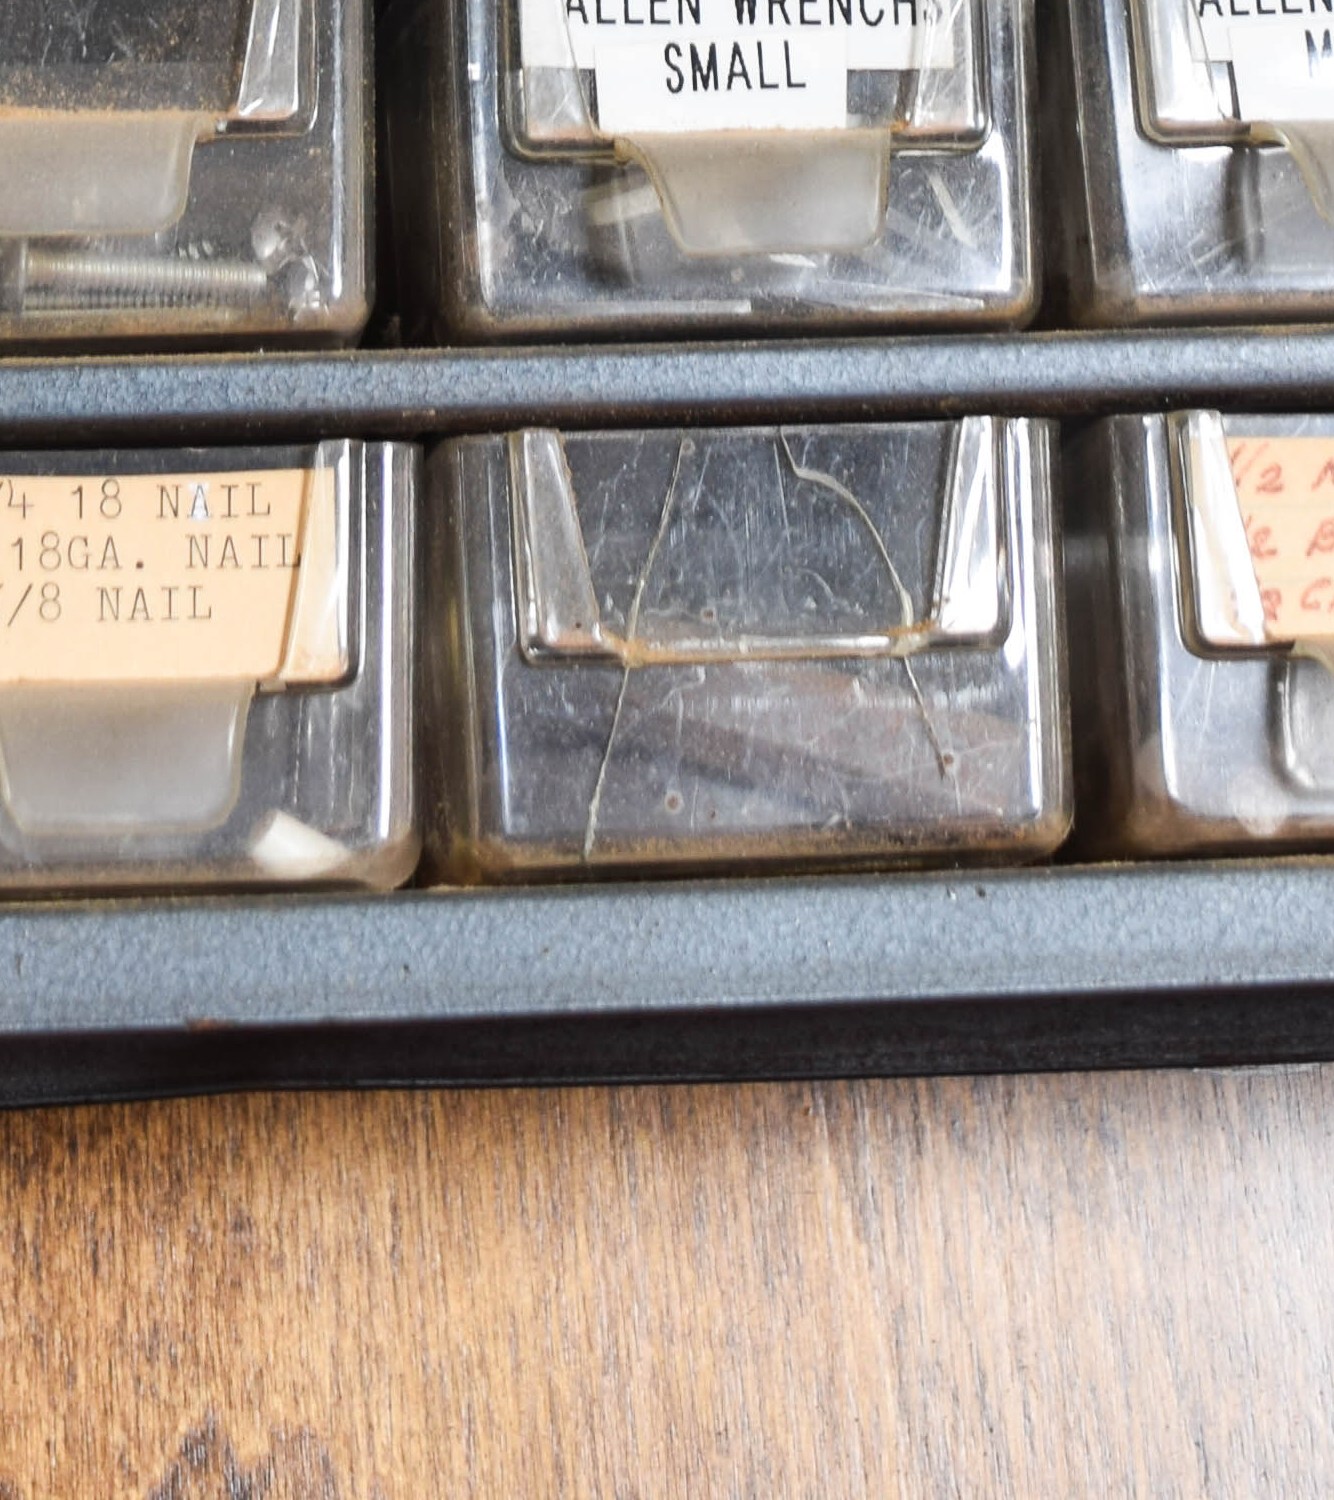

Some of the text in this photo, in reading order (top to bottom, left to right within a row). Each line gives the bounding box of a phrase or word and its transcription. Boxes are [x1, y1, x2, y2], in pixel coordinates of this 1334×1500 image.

[664, 40, 807, 94] SMALL
[70, 478, 272, 520] 18 NAIL
[186, 533, 301, 570] NAIL
[97, 585, 213, 622] NAIL
